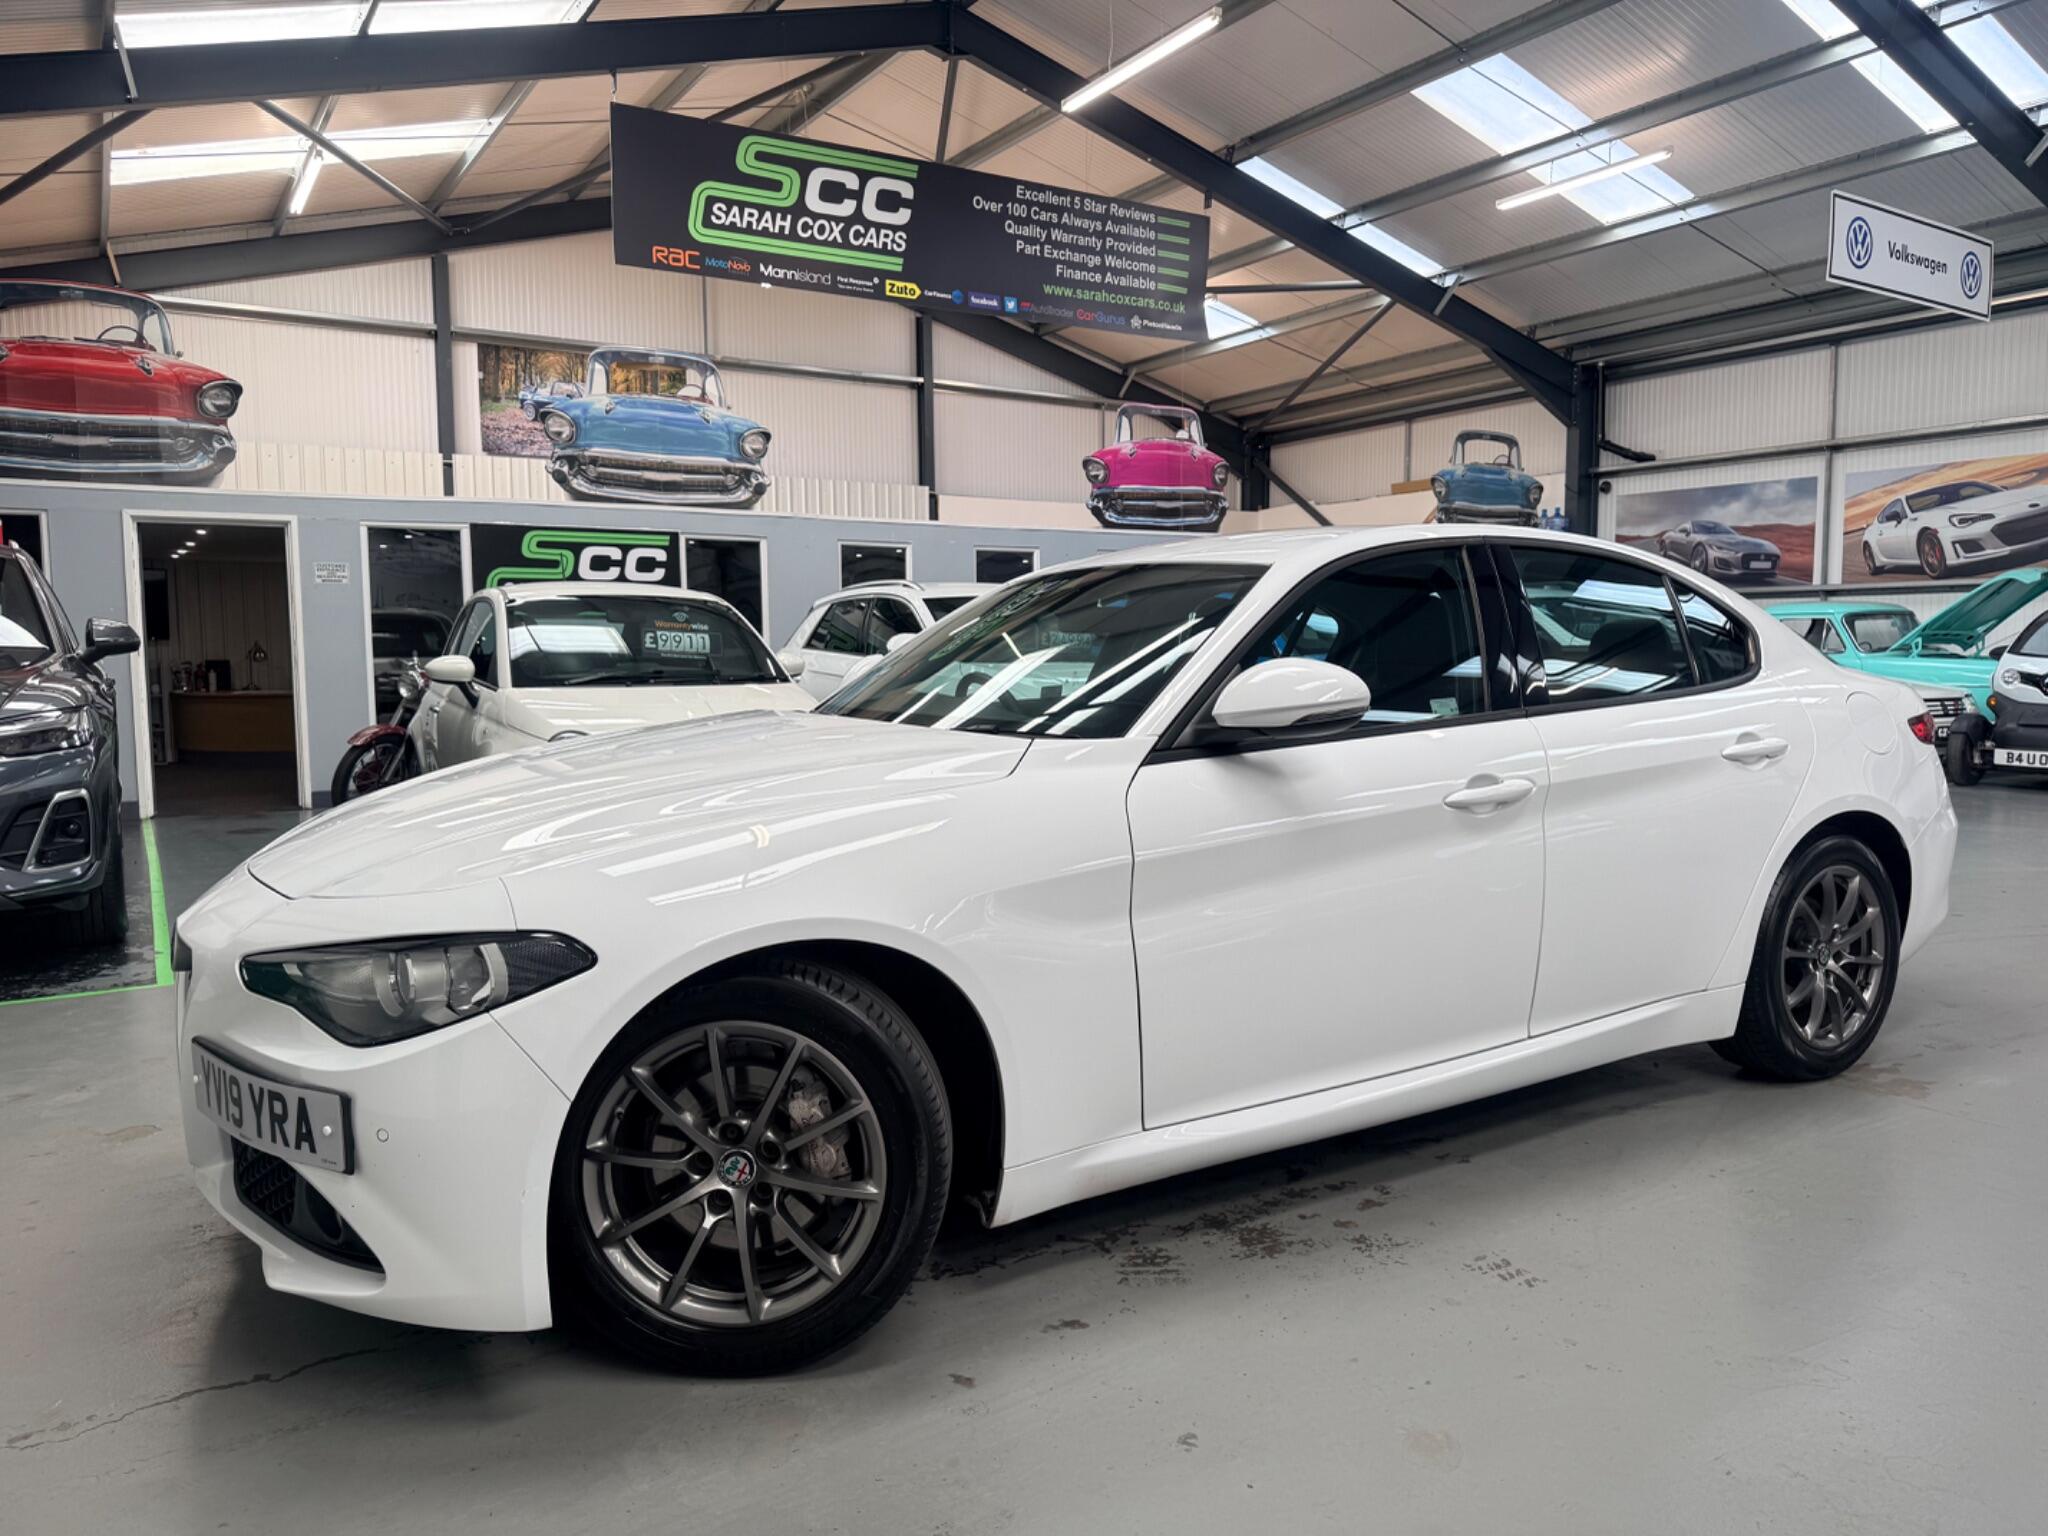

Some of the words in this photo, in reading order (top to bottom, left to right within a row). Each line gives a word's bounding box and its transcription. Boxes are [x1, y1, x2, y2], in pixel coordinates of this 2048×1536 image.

[973, 196, 1003, 213] Over
[1006, 202, 1028, 217] 100
[1030, 207, 1058, 223] Cars
[1061, 213, 1102, 232] Always
[1105, 220, 1156, 240] Available
[1016, 185, 1071, 207] Excellent
[1073, 199, 1081, 208] 5
[1083, 199, 1107, 215] Star
[1109, 204, 1156, 223] Reviews
[710, 203, 792, 235] SARAH
[796, 217, 844, 243] COX
[848, 225, 907, 252] CARS
[1004, 220, 1048, 241] Quality
[1050, 228, 1102, 250] Warranty
[1106, 237, 1156, 256] Provided
[1016, 240, 1041, 256] Part
[1044, 247, 1101, 266] Exchange
[1104, 254, 1156, 274] Welcome
[1888, 240, 1948, 275] Volkswagen
[888, 283, 916, 297] Zuto
[1056, 265, 1101, 282] Finance
[1104, 272, 1156, 291] Available
[1042, 283, 1186, 314] www.sarahcoxcars.co.uk
[1076, 308, 1126, 326] CarGurus
[644, 631, 707, 650] £9911
[248, 1082, 317, 1154] YRA
